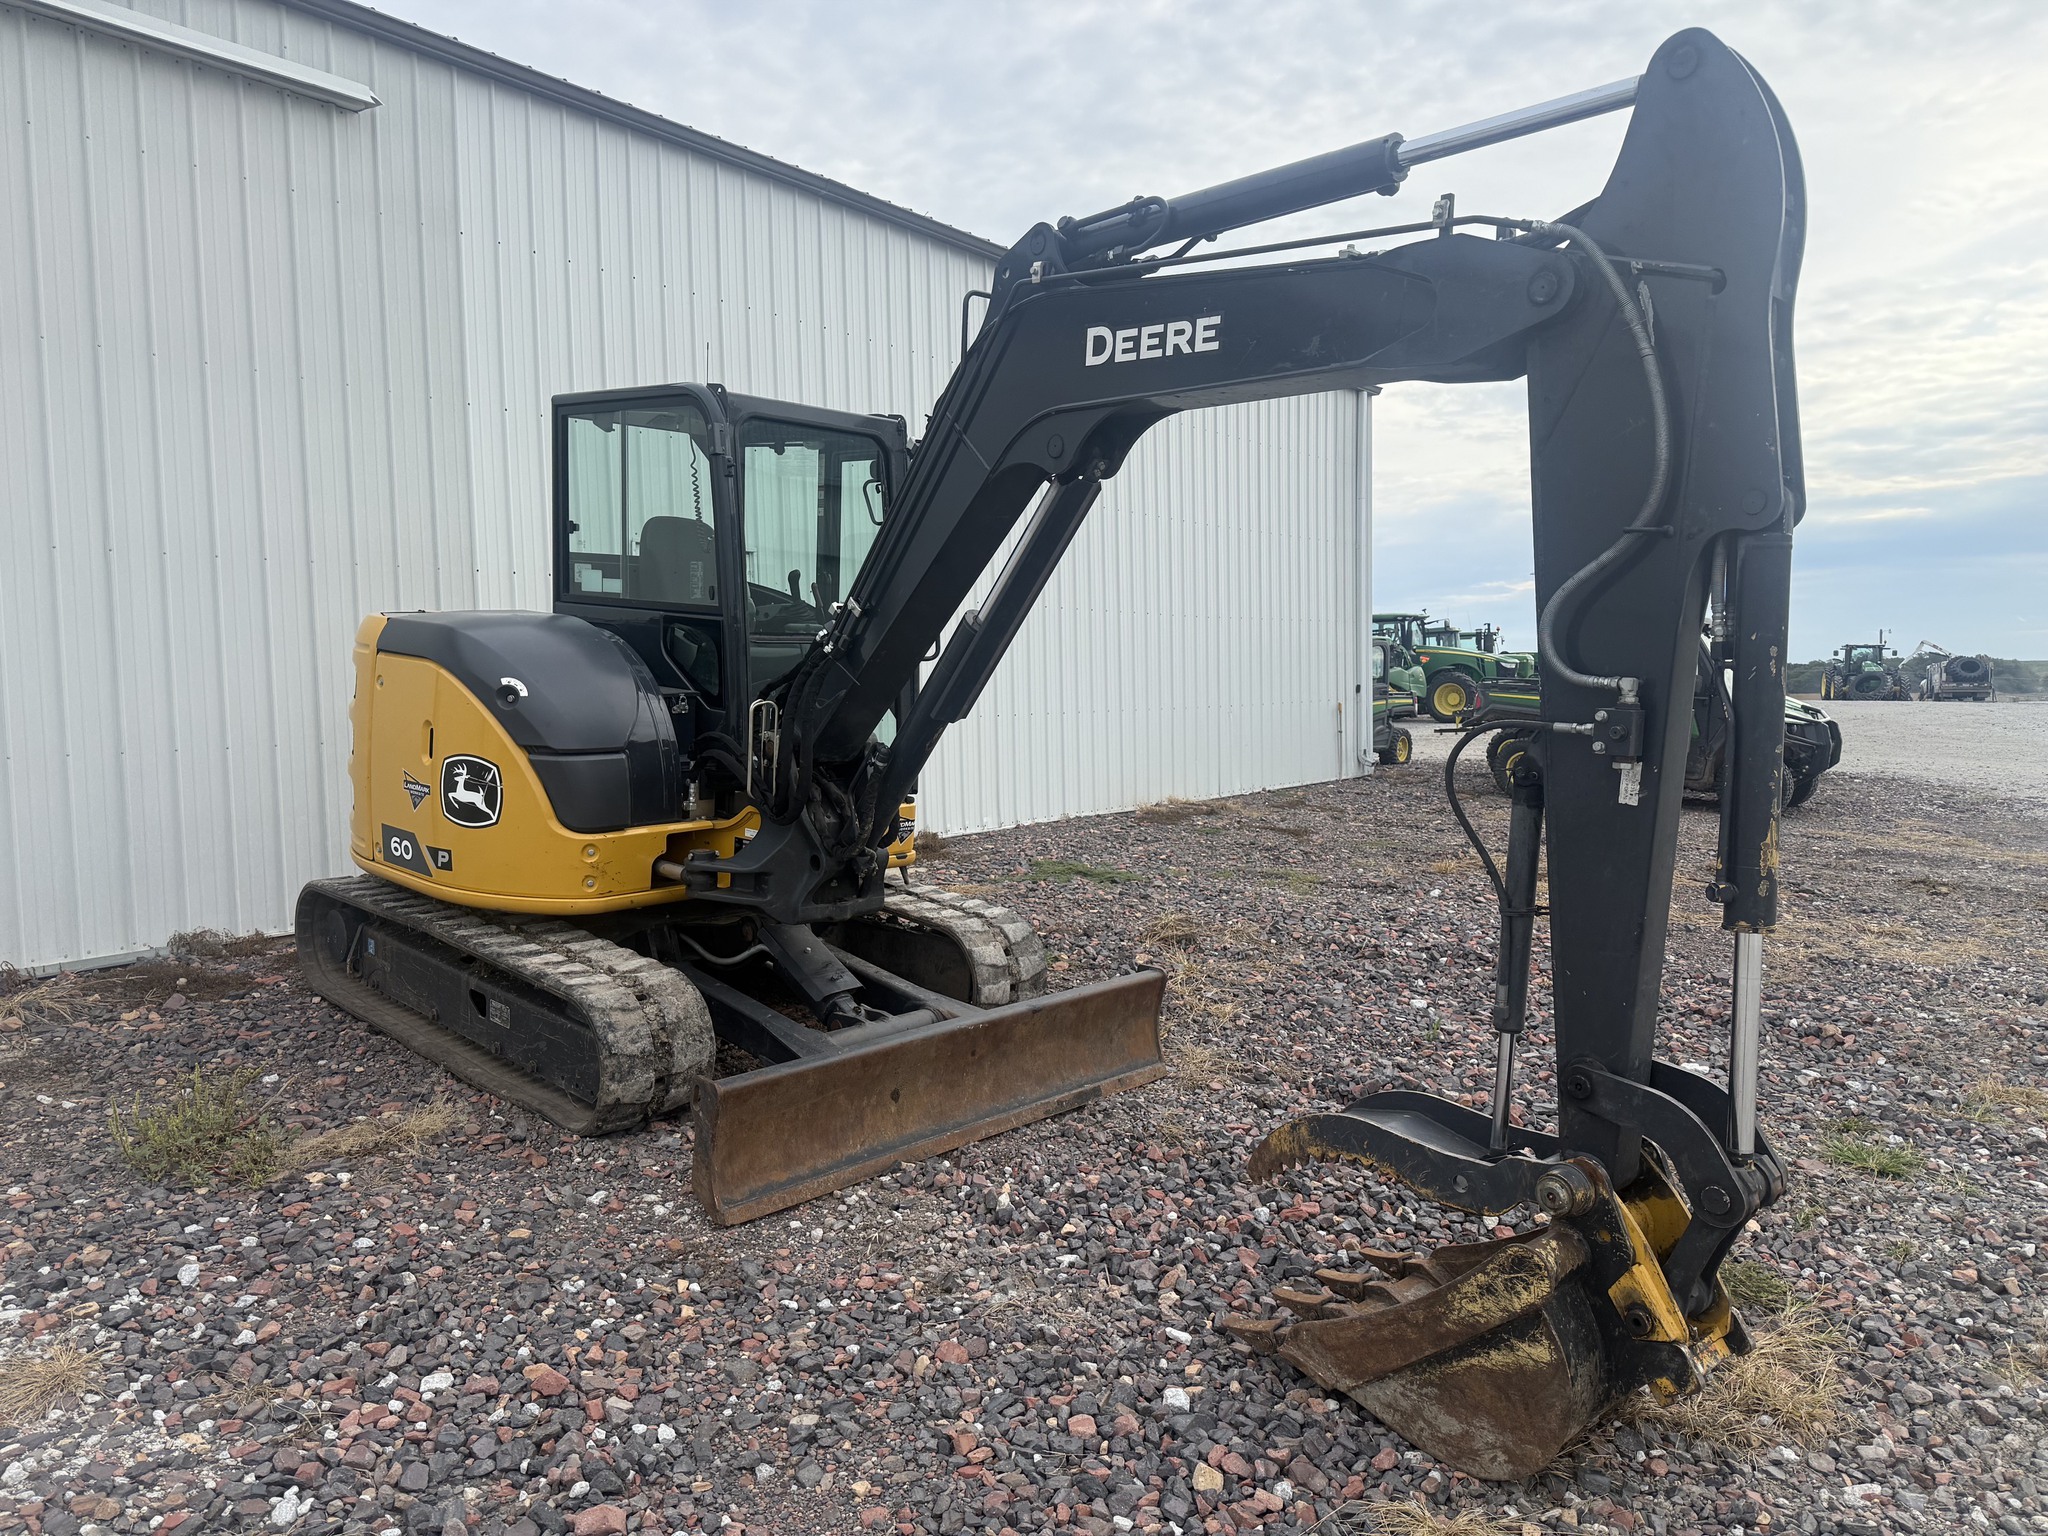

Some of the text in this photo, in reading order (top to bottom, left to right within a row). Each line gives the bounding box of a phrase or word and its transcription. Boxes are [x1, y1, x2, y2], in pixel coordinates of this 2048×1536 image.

[1085, 315, 1221, 366] DEERE
[390, 836, 449, 867] 60 P
